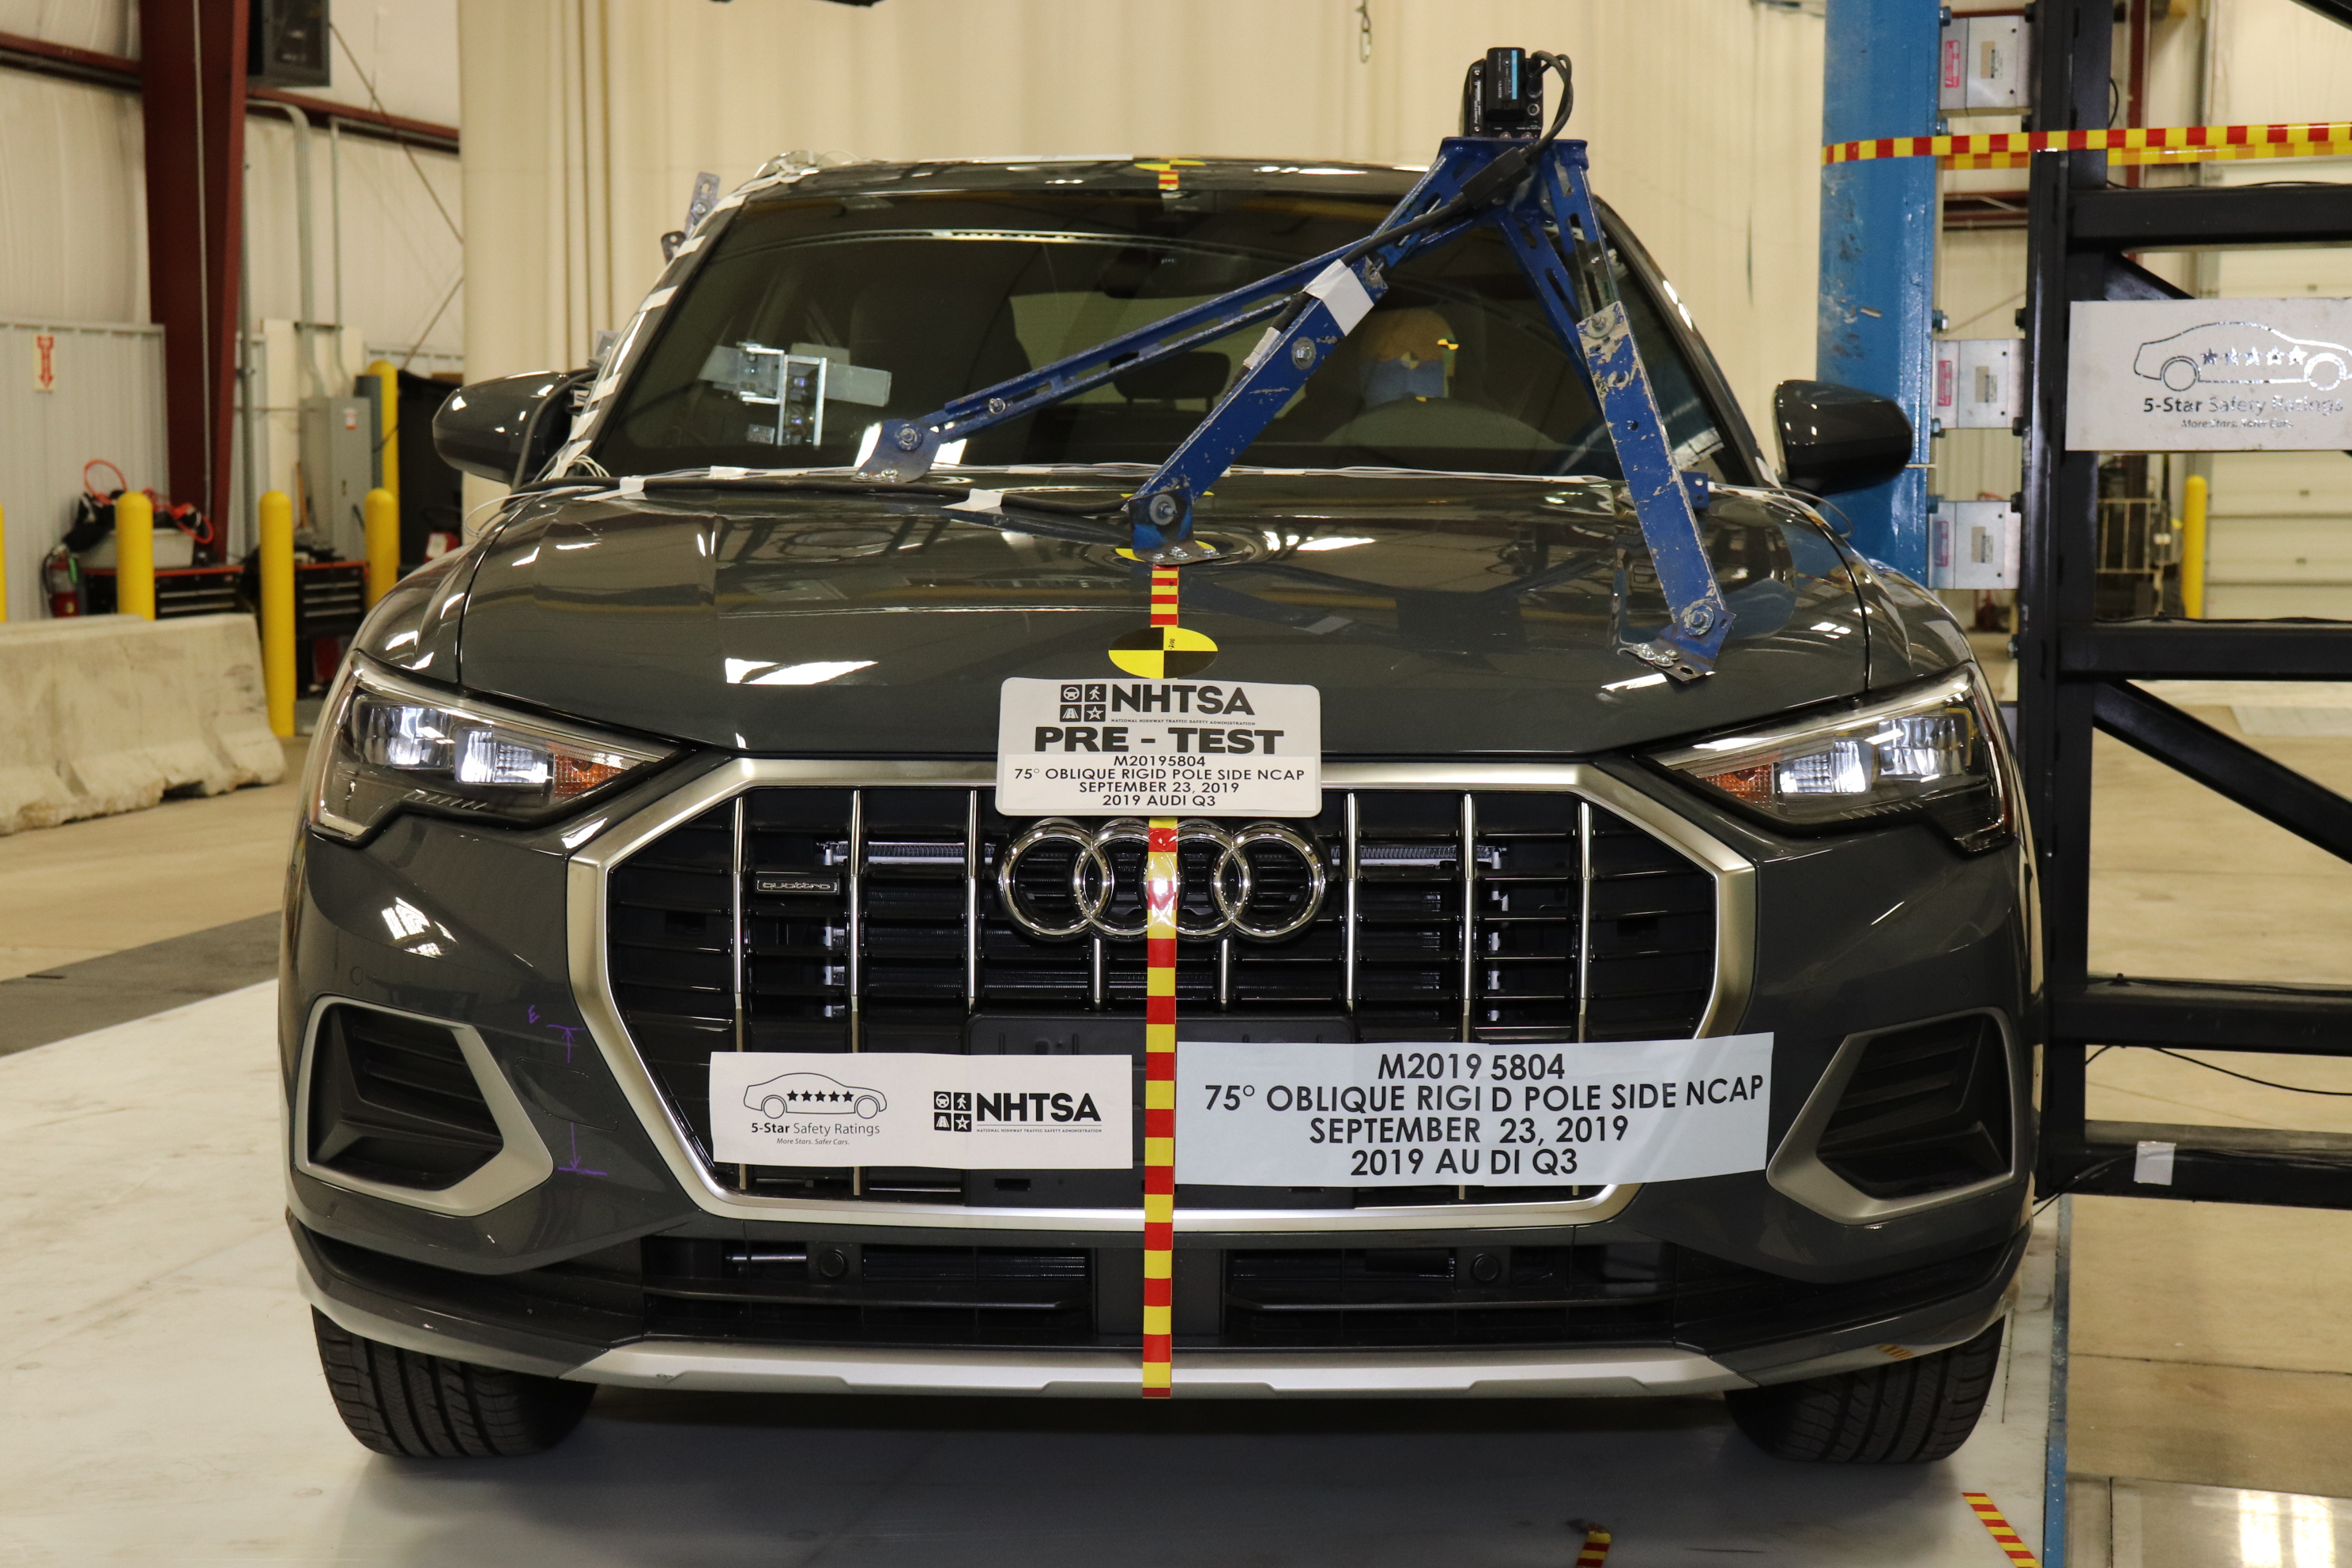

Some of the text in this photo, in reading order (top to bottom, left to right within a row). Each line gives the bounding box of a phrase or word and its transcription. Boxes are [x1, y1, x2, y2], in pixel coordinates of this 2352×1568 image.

[2143, 394, 2344, 416] 5-Star Safety Ratings
[1112, 684, 1254, 715] NHTSA
[1035, 727, 1129, 752] PRE
[1168, 727, 1283, 754] TEST
[1114, 756, 1205, 767] M20195804
[1046, 769, 1114, 779] OBLIQUE
[1122, 769, 1166, 778] RIGID
[1173, 769, 1211, 779] POLE
[1218, 770, 1250, 780] SIDE
[1258, 770, 1304, 780] NCAP
[1080, 782, 1238, 795] SEPTEMBER 23, 2019
[1103, 795, 1215, 806] 2019 AUDI Q3
[762, 881, 831, 891] quattro
[1267, 1086, 1404, 1114] OBLIQUE
[1525, 1085, 1600, 1111] POLE
[1611, 1083, 1675, 1110] SIDE
[1687, 1075, 1762, 1106] NCAP
[977, 1093, 1101, 1121] NHTSA
[752, 1123, 880, 1136] 5-Star Safety Ratings
[1310, 1116, 1628, 1146] SEPTEMBER 23, 2019
[1351, 1148, 1423, 1175] 2019
[1532, 1148, 1577, 1175] Q3
